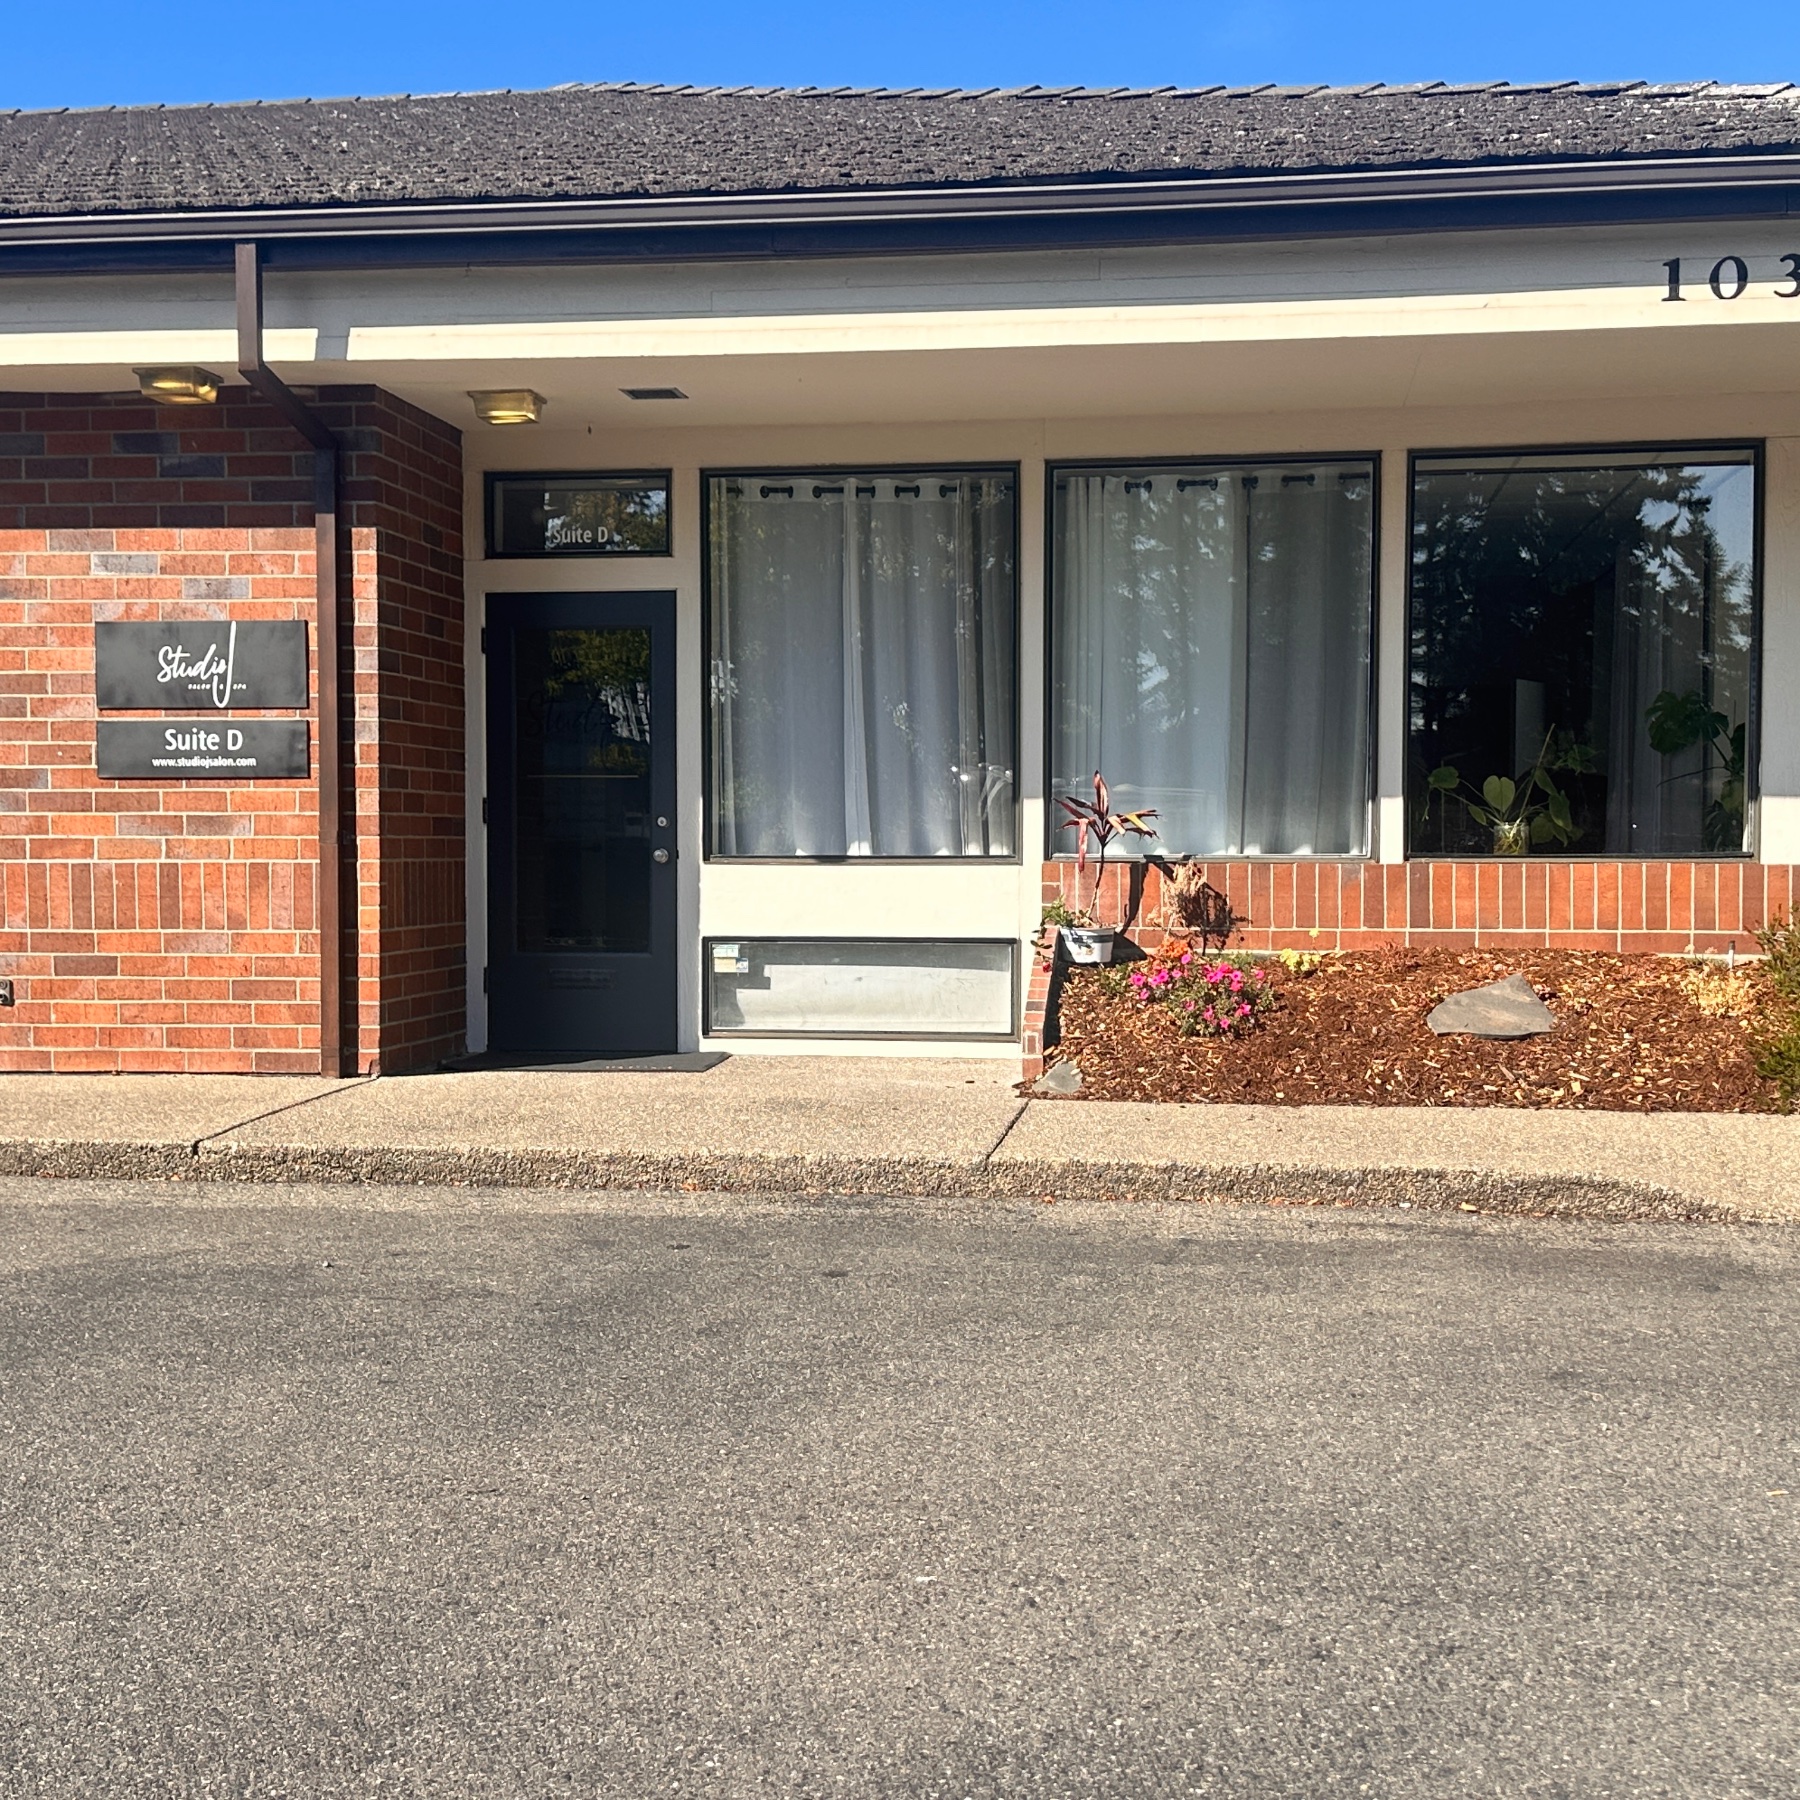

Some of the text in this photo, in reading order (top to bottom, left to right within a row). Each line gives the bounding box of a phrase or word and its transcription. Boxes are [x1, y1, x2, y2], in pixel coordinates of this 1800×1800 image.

[1661, 253, 1800, 301] 103
[553, 526, 609, 544] Suite D
[157, 643, 227, 683] Studio
[164, 727, 243, 751] Suite D
[151, 755, 257, 769] www.studiojsalon.com
